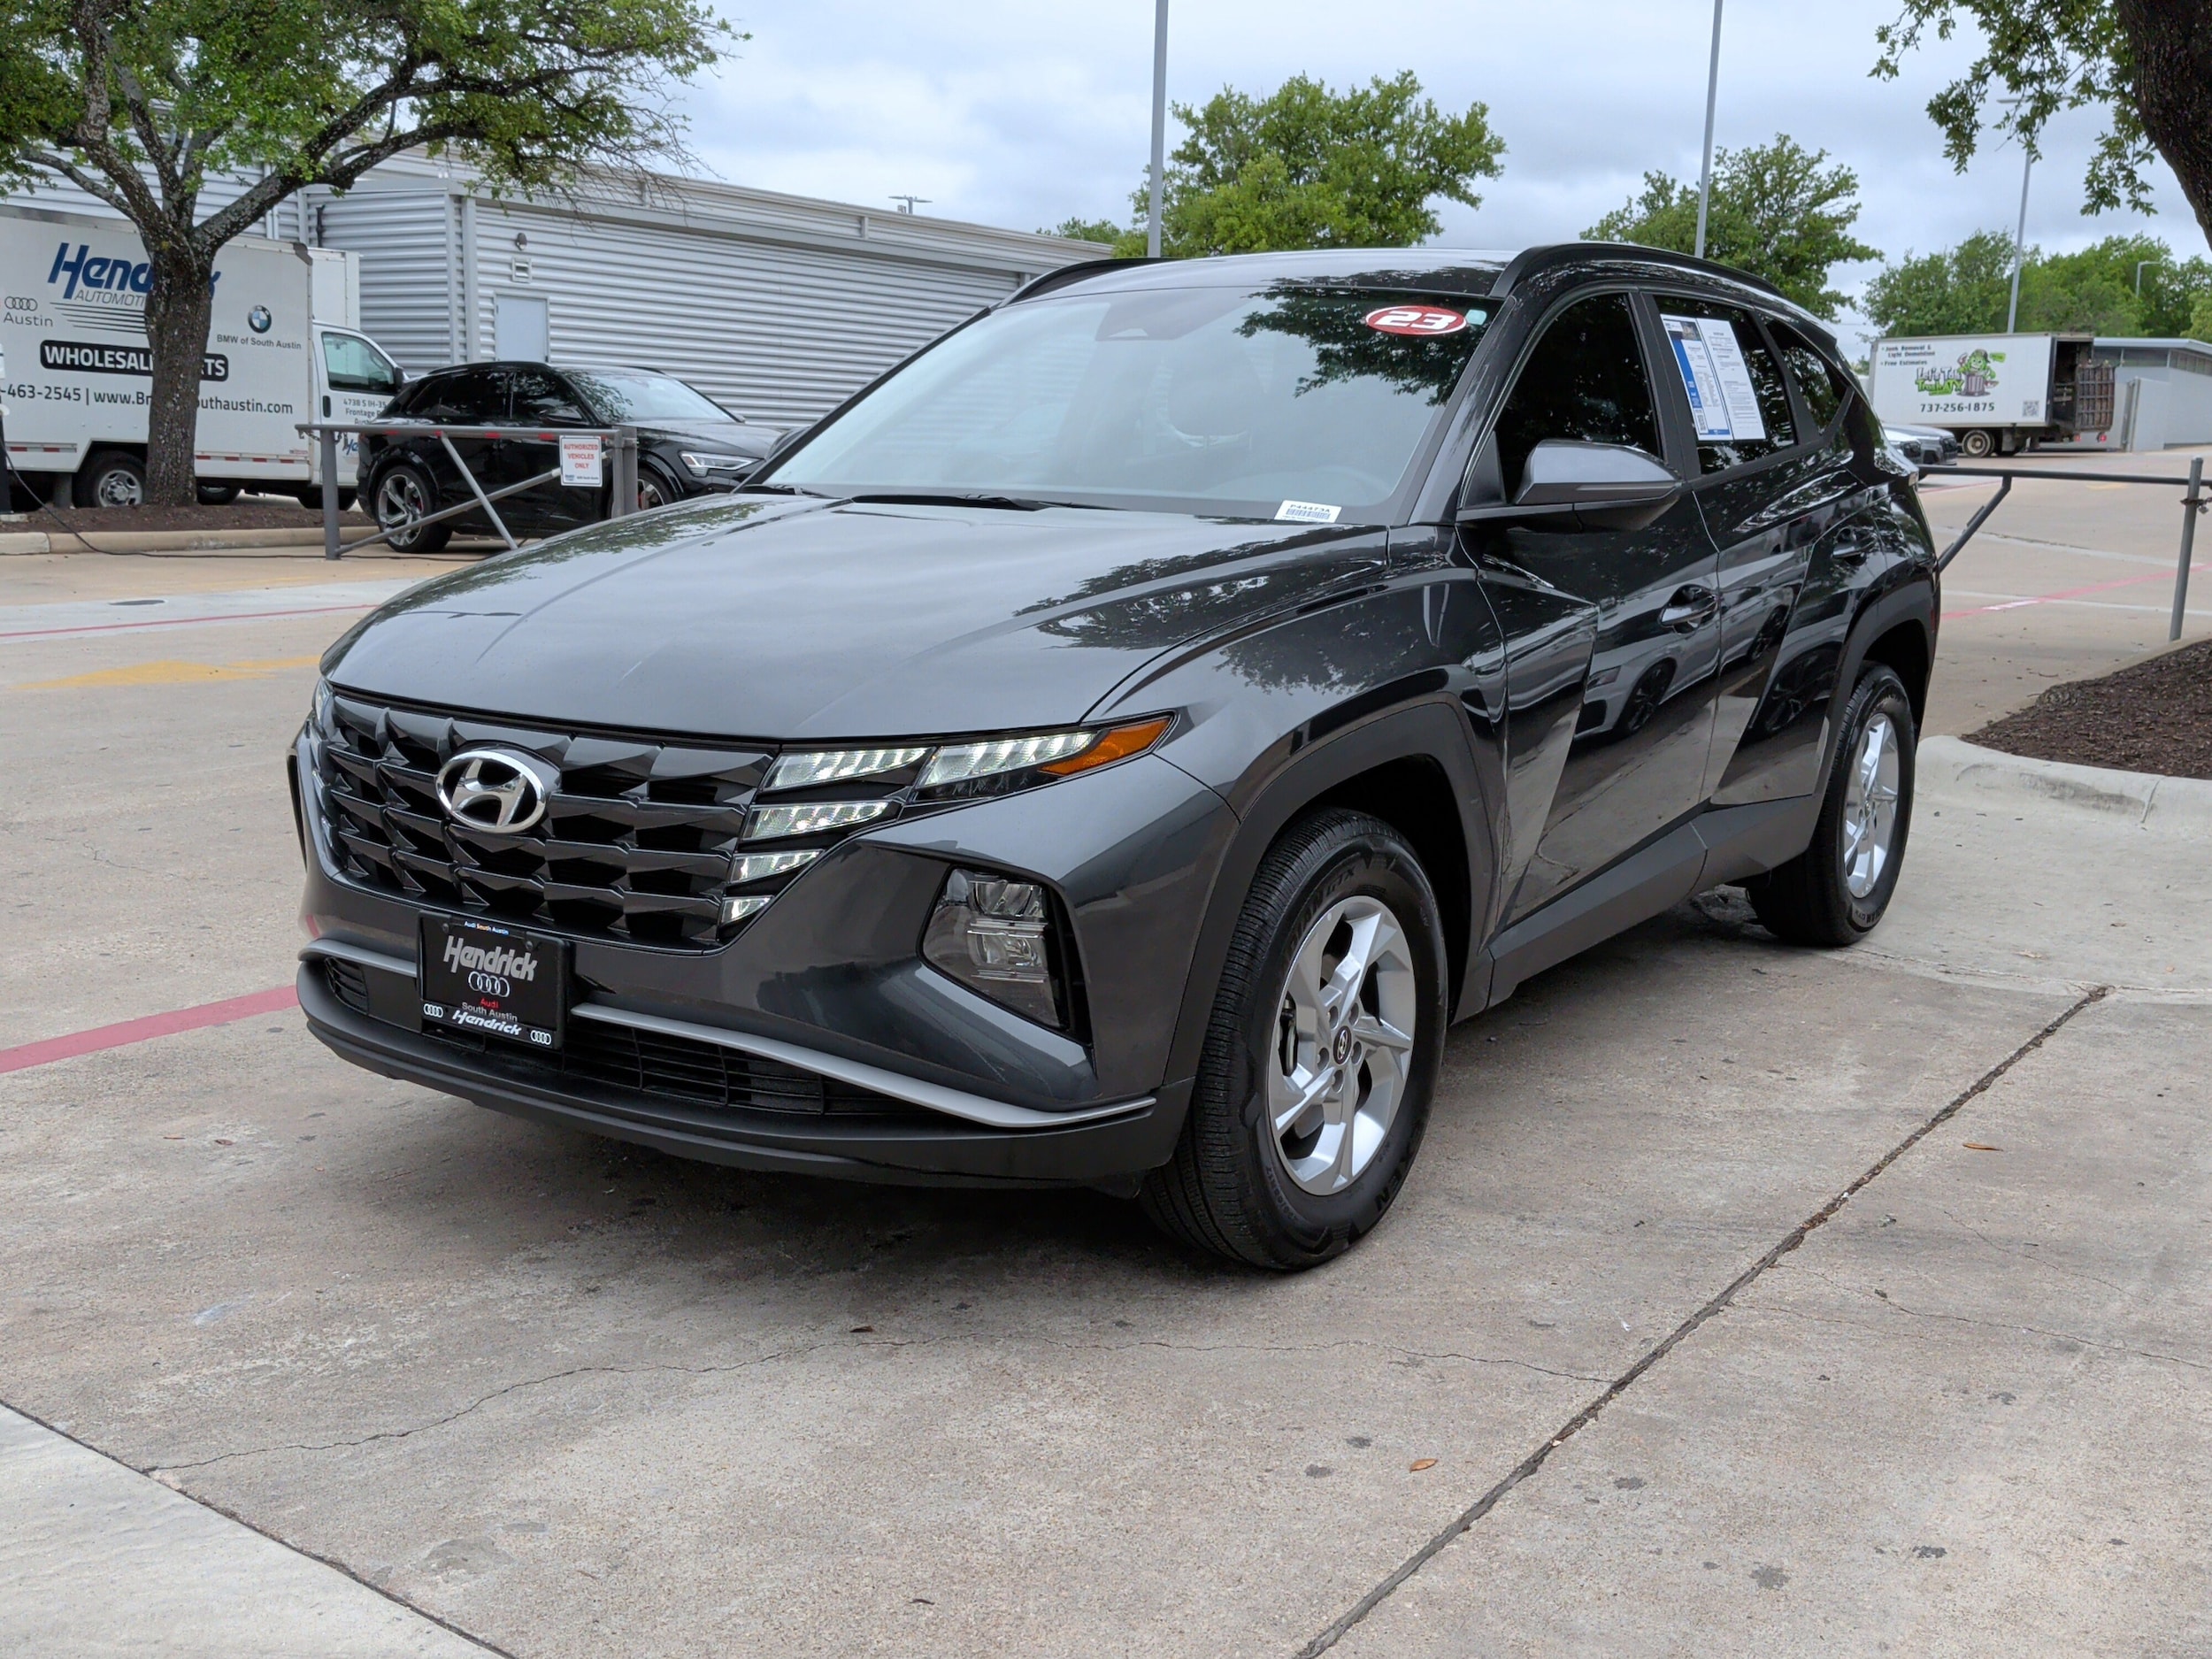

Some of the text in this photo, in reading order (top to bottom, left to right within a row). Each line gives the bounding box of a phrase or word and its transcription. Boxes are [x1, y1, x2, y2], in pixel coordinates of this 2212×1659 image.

[74, 289, 148, 307] AUTOMOTI
[4, 312, 53, 326] Austin
[1373, 311, 1457, 330] 23
[217, 334, 239, 344] BMW
[250, 337, 274, 348] South
[276, 341, 302, 350] Austin
[345, 407, 375, 418] Frontage
[1920, 402, 1994, 412] 737-256-1875
[493, 926, 509, 935] Austin
[443, 935, 537, 981] Hendrick
[480, 998, 499, 1009] Audi
[462, 1002, 518, 1022] South Austin
[452, 1010, 522, 1035] Hendrick
